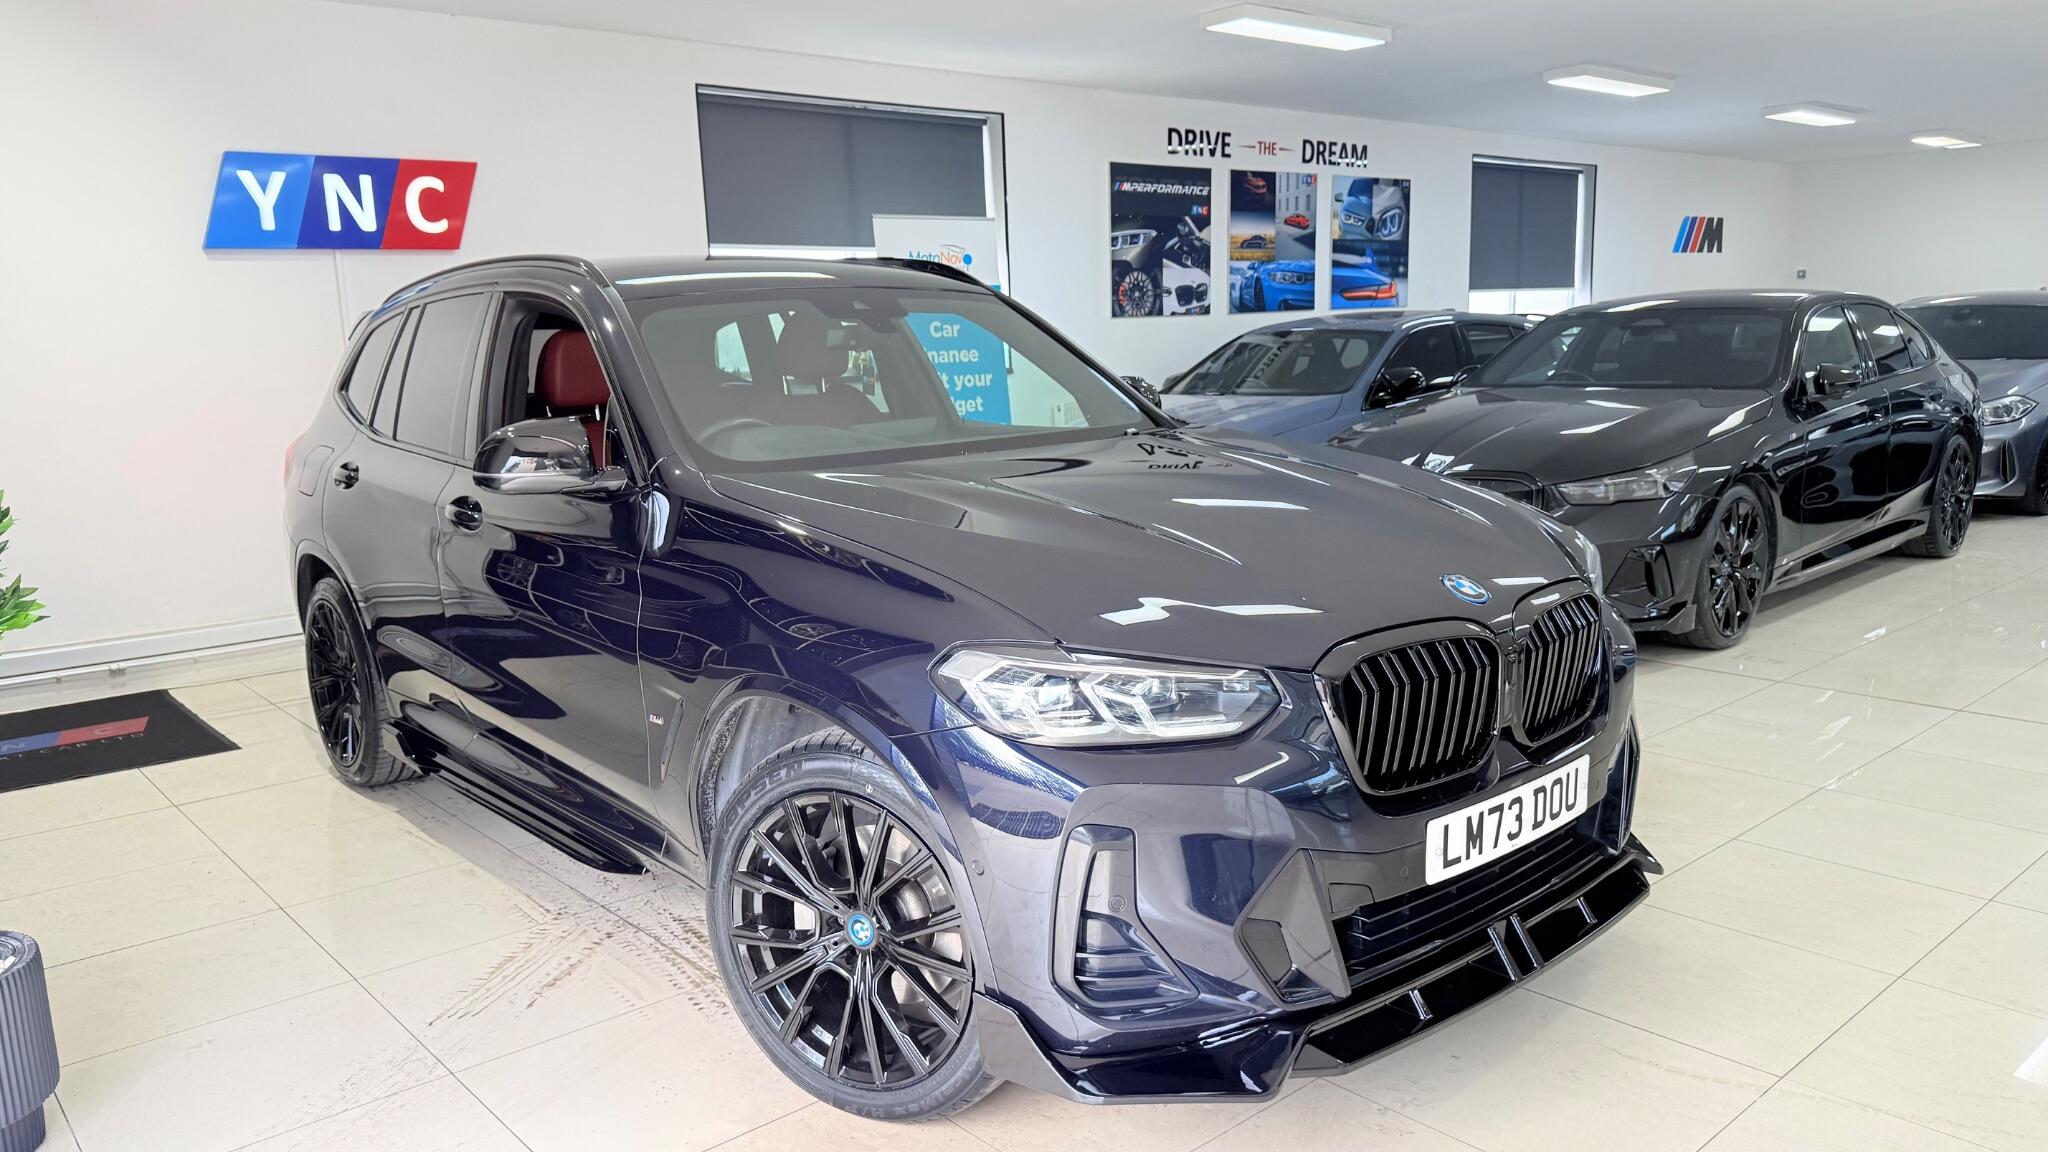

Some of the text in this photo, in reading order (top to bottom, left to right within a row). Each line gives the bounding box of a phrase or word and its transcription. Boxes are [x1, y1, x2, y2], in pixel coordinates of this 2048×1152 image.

[1167, 127, 1368, 168] DRIVE THE DREAM
[236, 168, 449, 234] YNC
[929, 320, 960, 338] Car
[924, 346, 979, 364] nance
[953, 372, 993, 392] your
[950, 395, 984, 417] get
[1443, 767, 1579, 869] LM73 DOU
